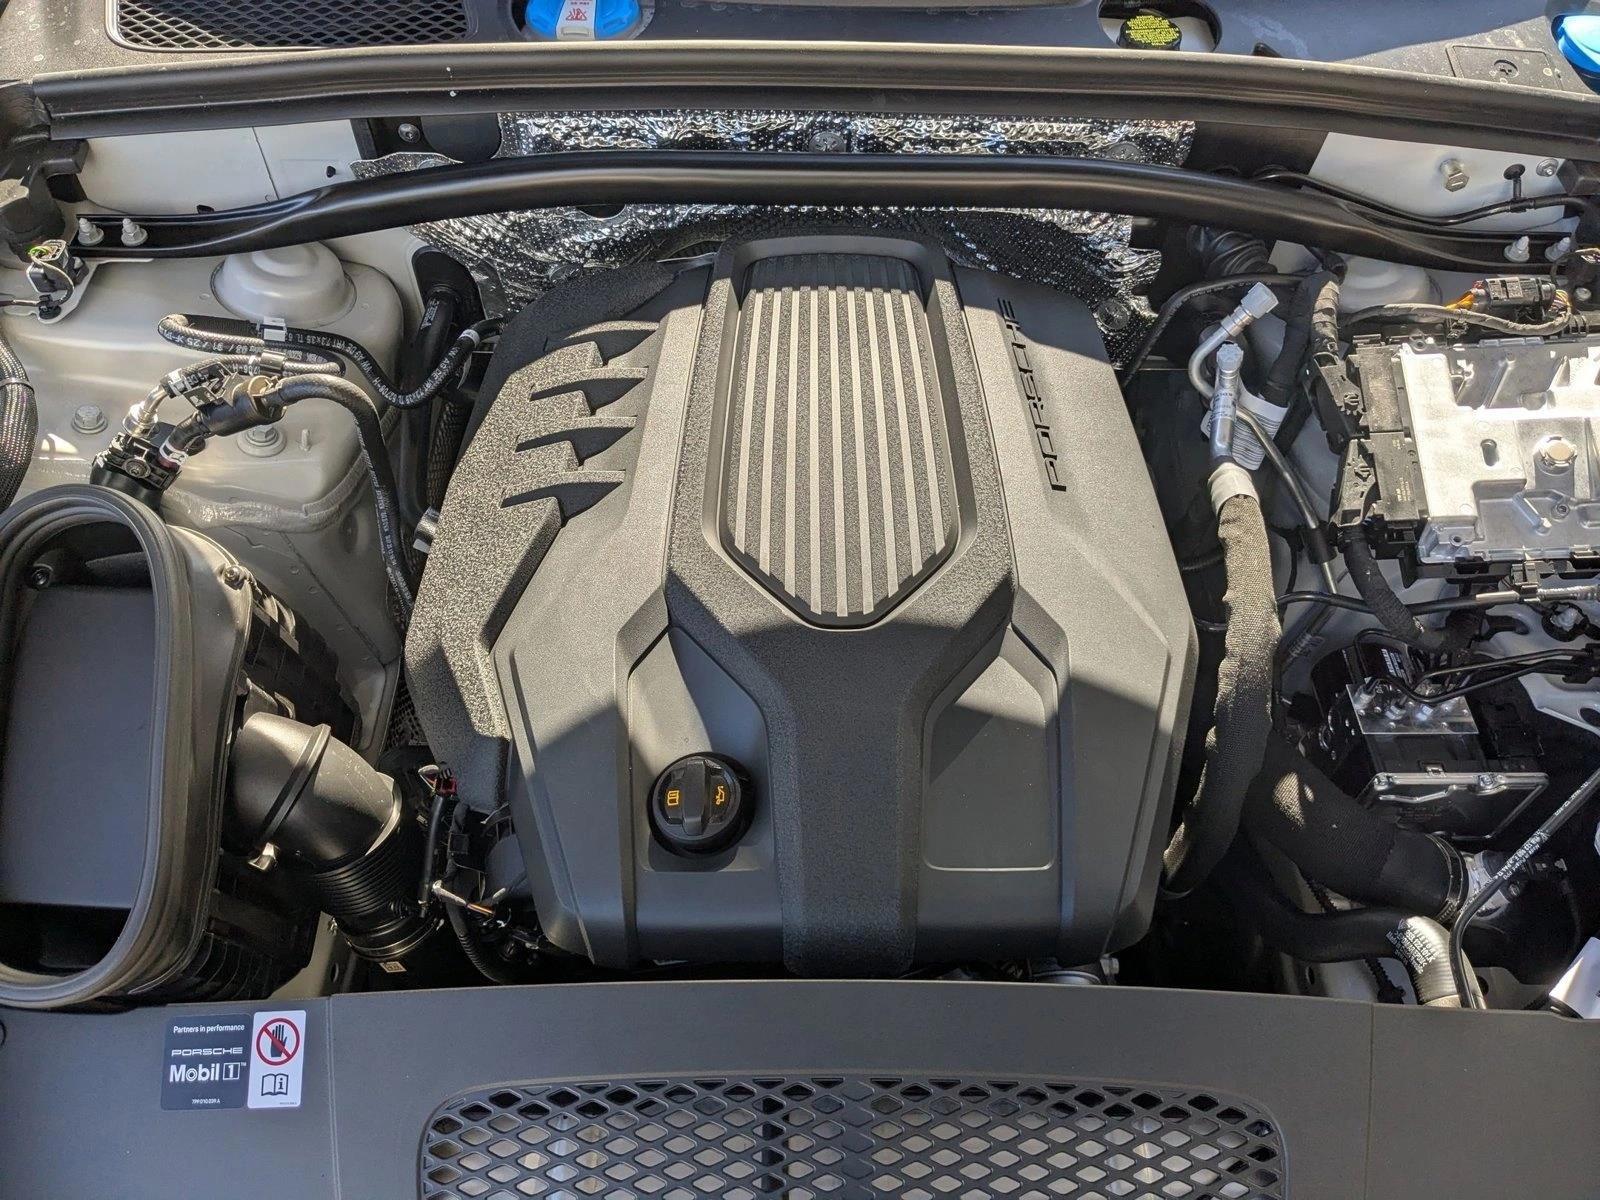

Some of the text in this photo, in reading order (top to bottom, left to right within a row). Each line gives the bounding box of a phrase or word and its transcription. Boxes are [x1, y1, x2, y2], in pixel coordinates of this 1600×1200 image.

[998, 298, 1067, 492] PORSCHE
[173, 1024, 245, 1034] Partners in performance
[171, 1047, 243, 1056] PORSCHE
[169, 1063, 220, 1083] Mobil
